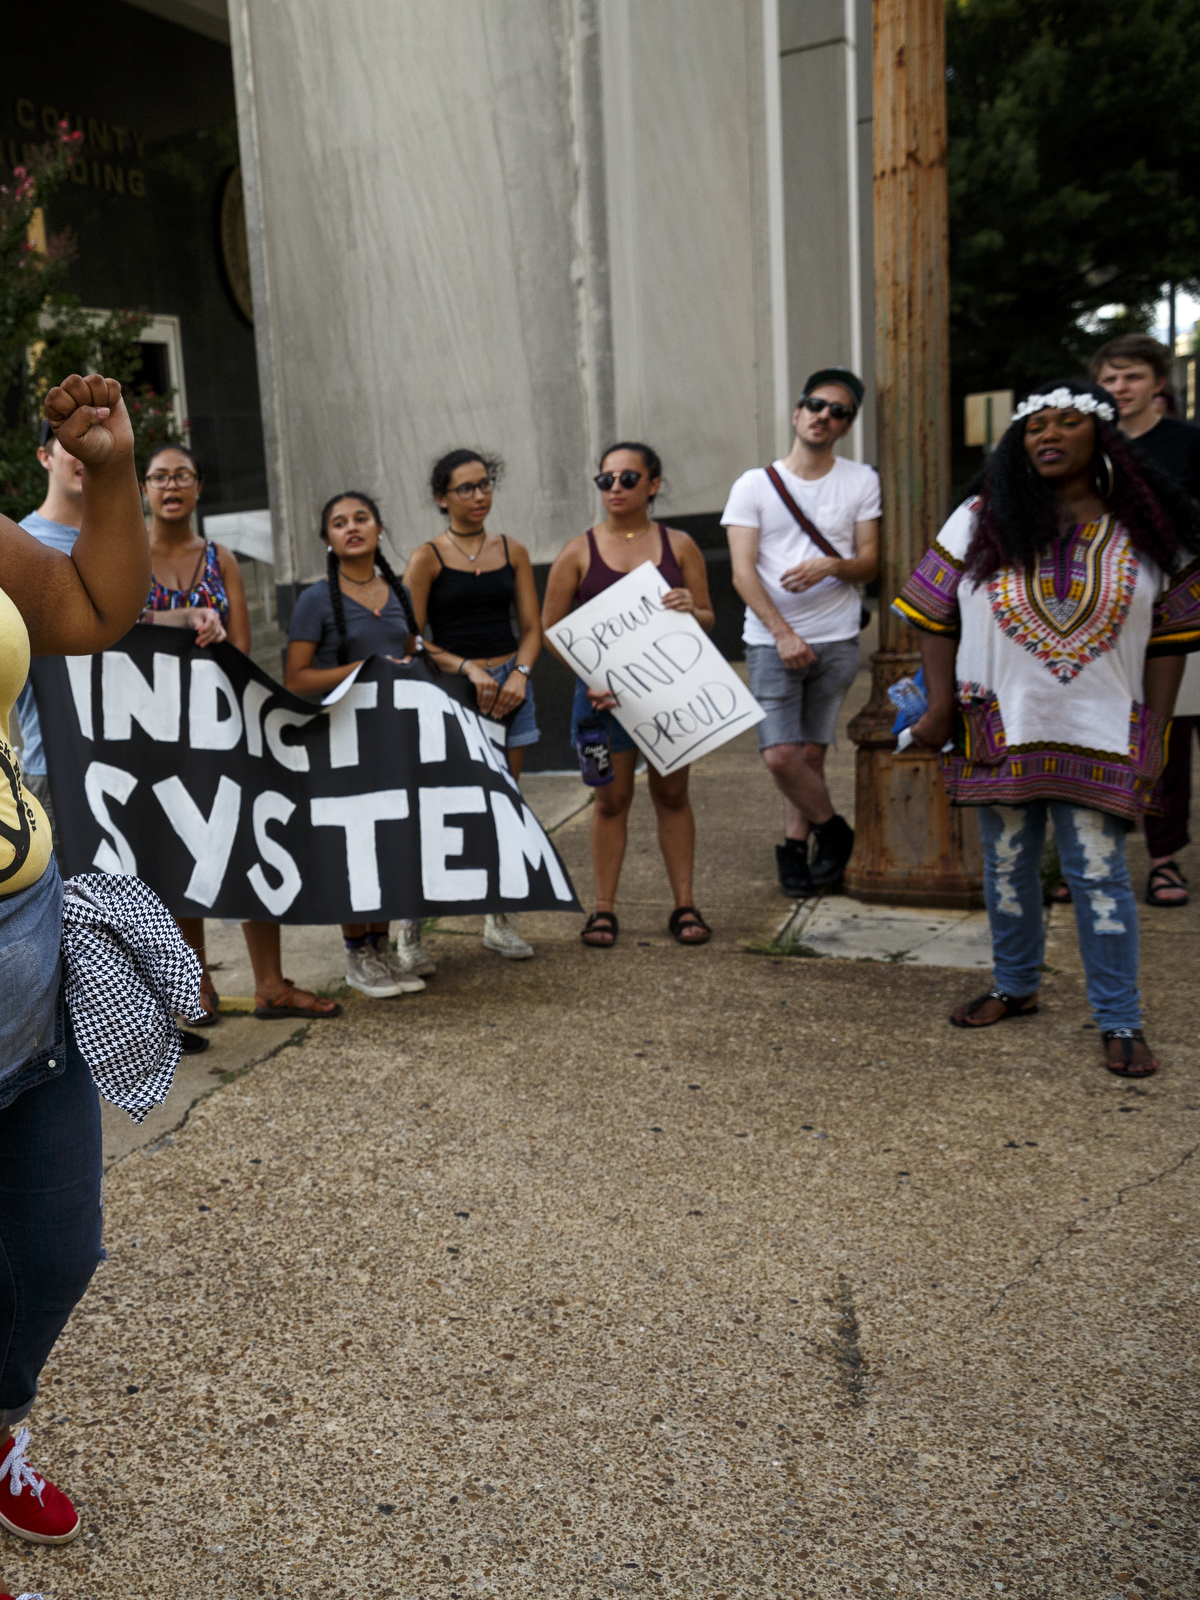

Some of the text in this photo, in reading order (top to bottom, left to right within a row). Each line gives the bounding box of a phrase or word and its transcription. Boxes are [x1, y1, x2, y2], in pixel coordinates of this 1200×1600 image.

[556, 585, 668, 676] BROWN
[606, 631, 703, 709] AND
[64, 651, 521, 797] INDICT THE
[632, 681, 737, 765] PROUD
[84, 761, 574, 916] SYSTEM
